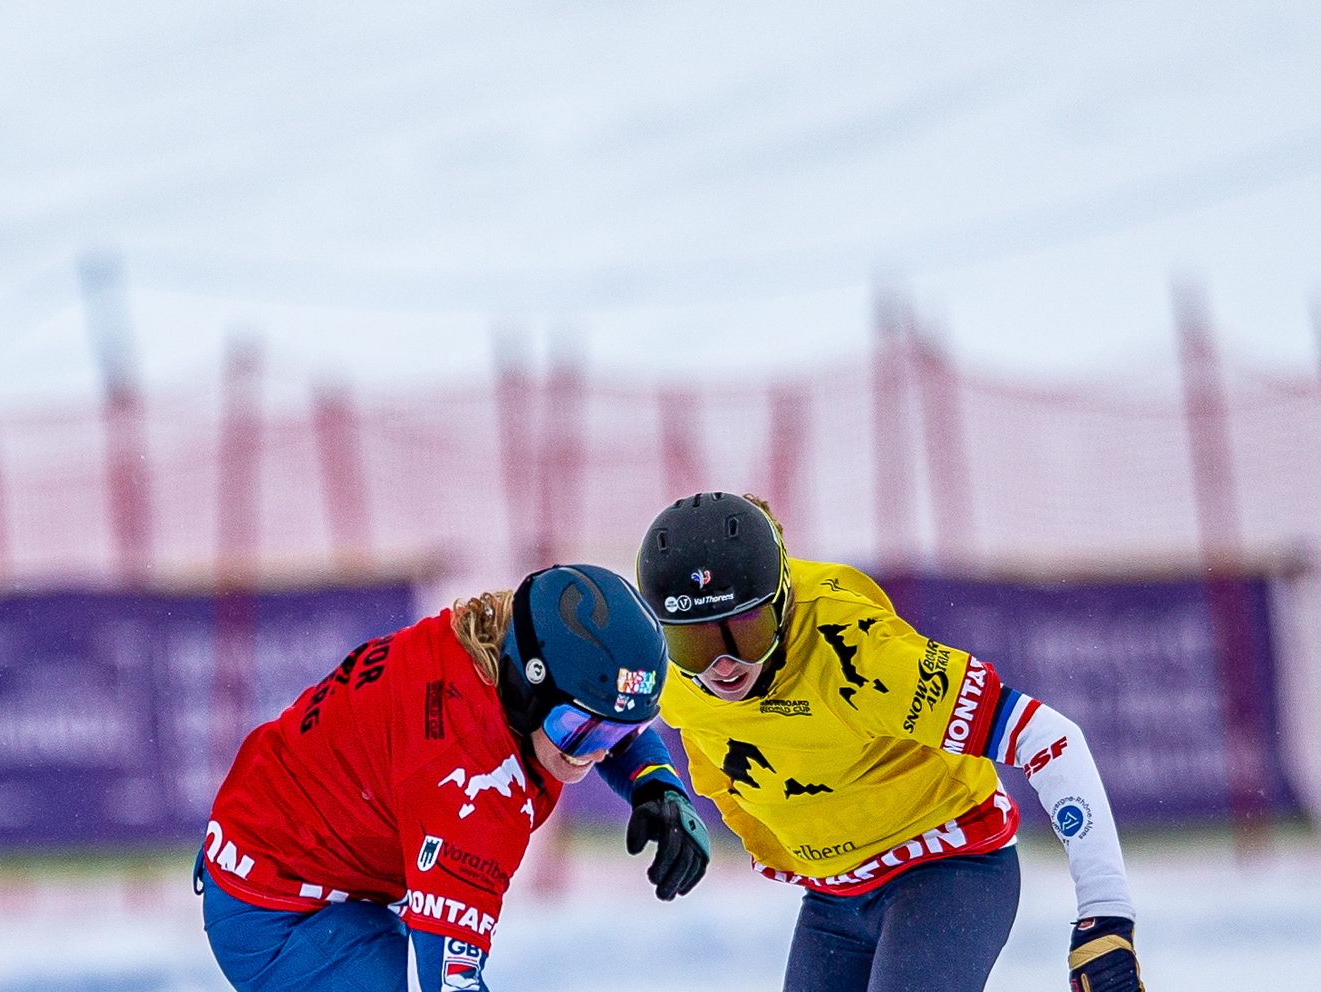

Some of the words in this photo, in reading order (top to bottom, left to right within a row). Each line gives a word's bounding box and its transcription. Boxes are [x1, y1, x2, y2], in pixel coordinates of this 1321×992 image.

[694, 597, 705, 605] Val
[706, 593, 734, 604] Thorens
[447, 938, 479, 958] GB
